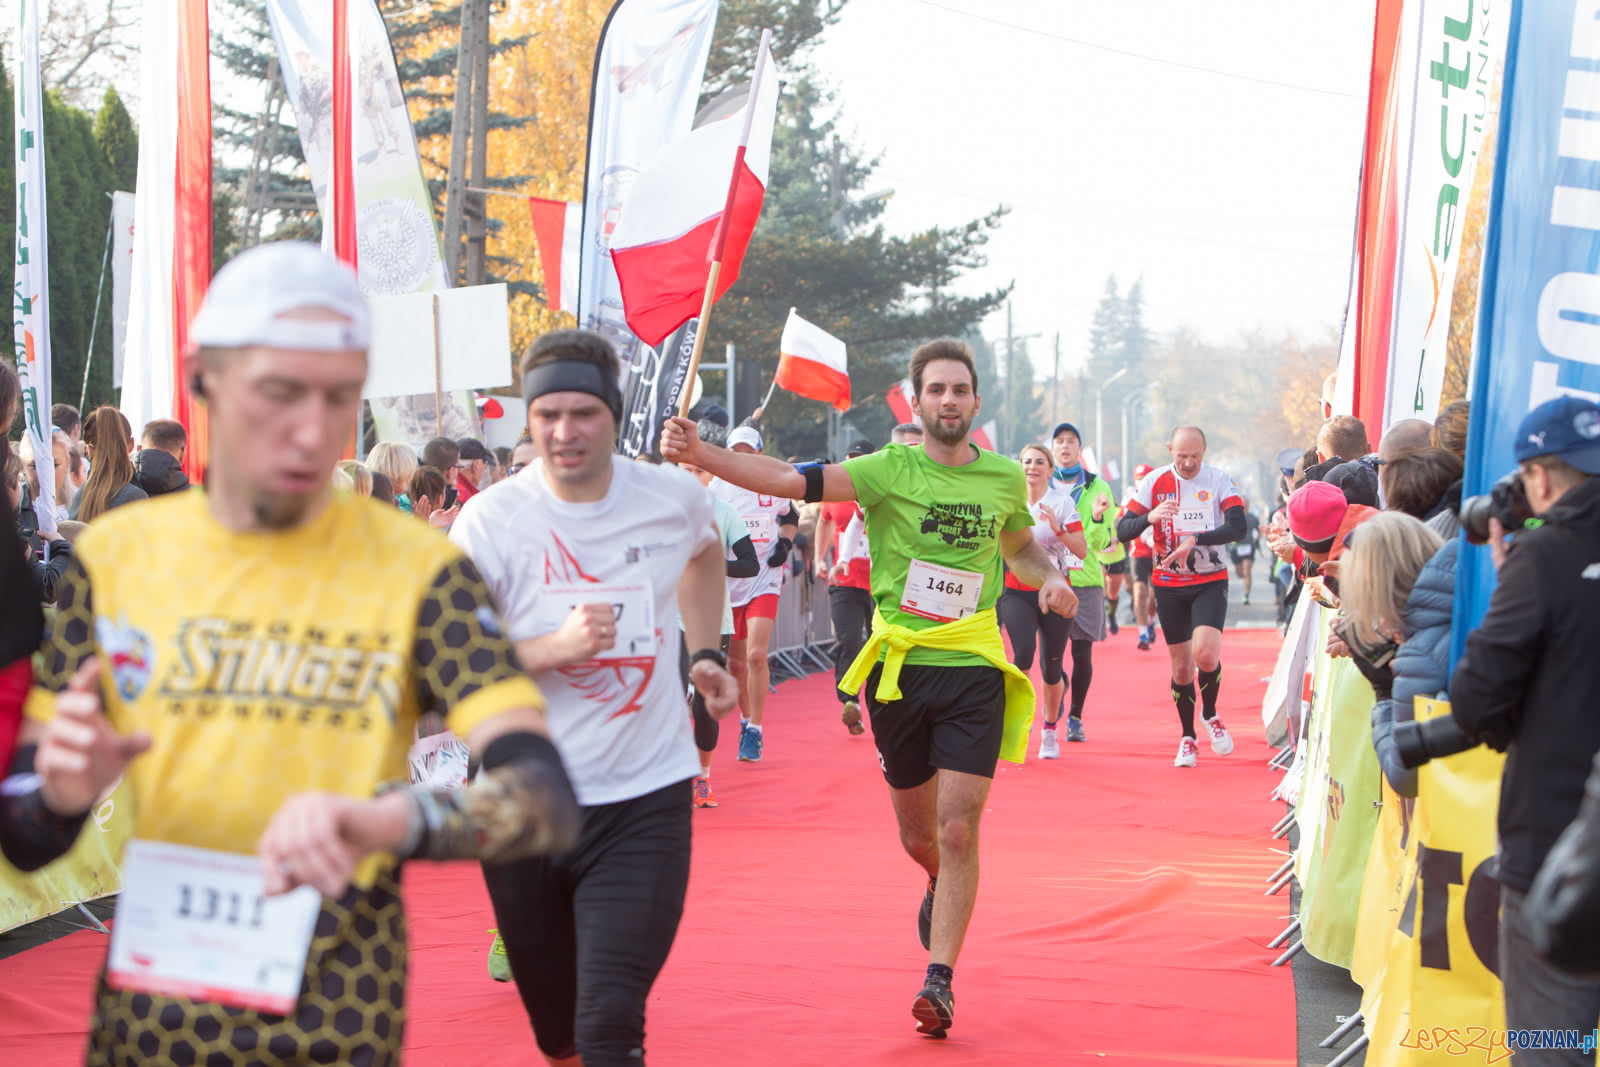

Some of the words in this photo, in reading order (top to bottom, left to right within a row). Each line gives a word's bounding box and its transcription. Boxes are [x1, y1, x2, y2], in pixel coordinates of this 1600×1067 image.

[1183, 512, 1204, 520] 1225
[926, 577, 963, 596] 1464
[159, 616, 401, 726] STINGER
